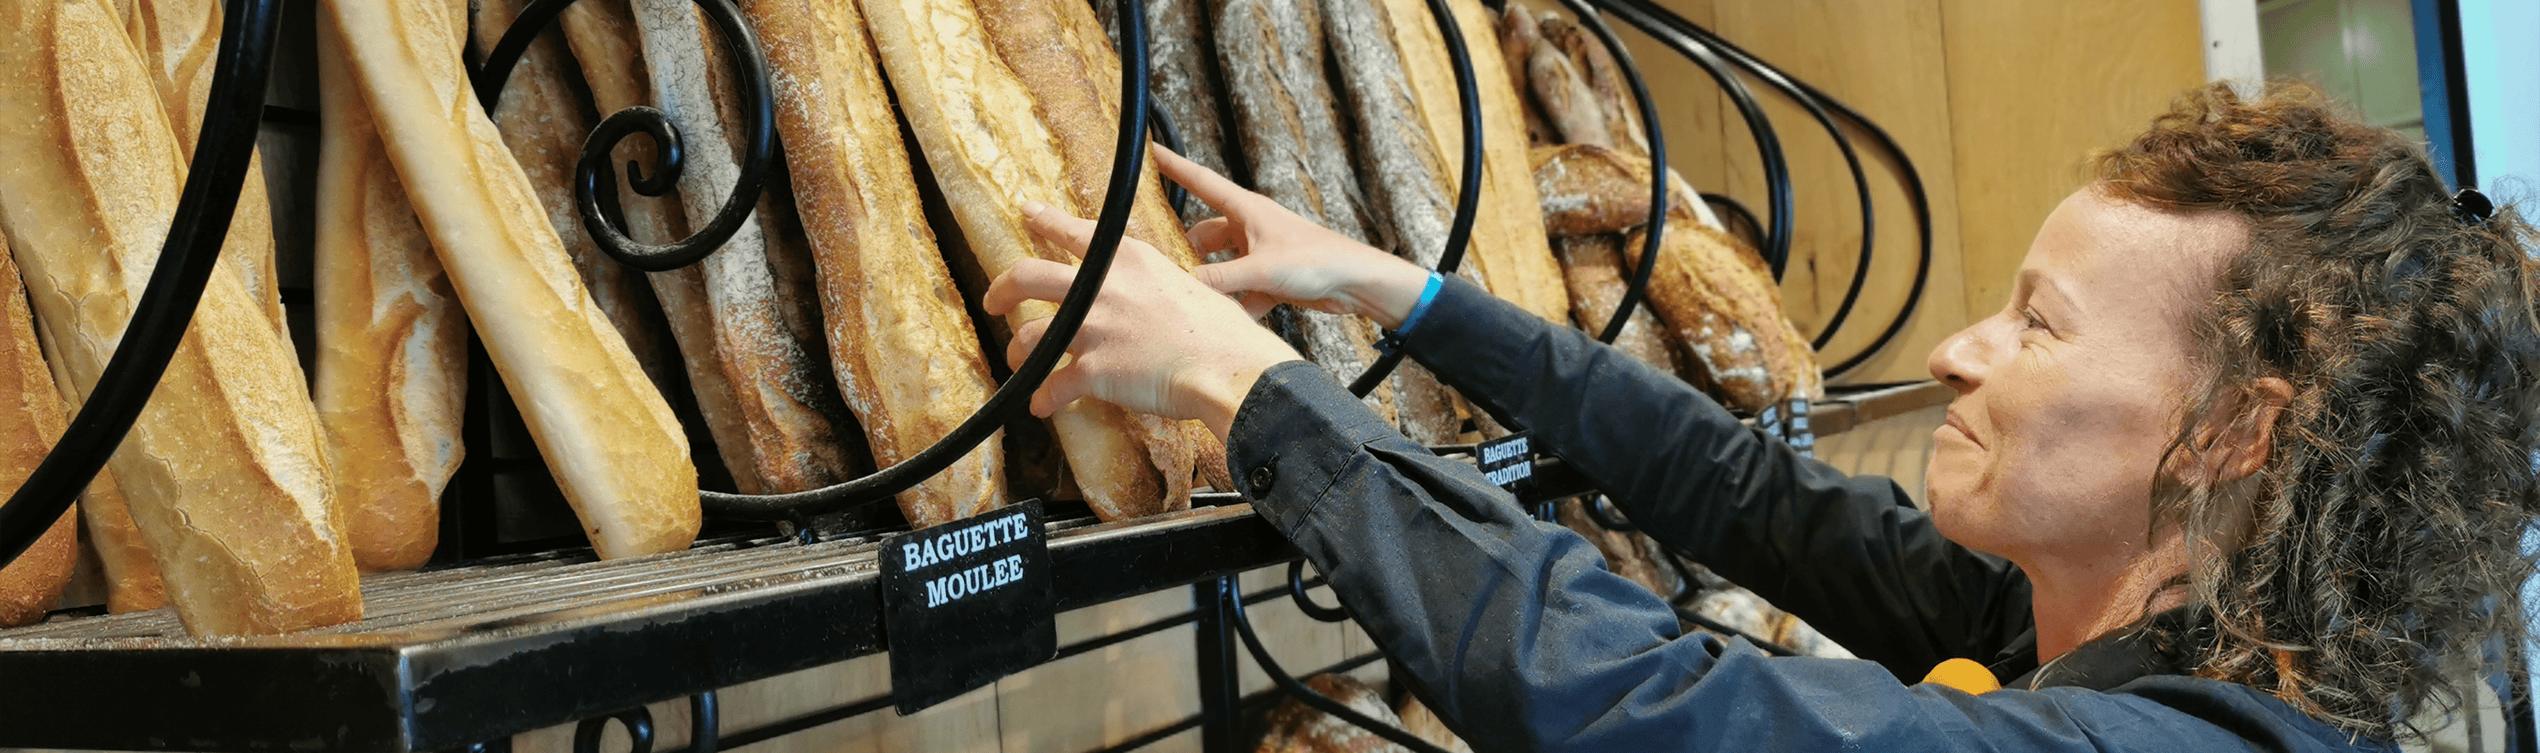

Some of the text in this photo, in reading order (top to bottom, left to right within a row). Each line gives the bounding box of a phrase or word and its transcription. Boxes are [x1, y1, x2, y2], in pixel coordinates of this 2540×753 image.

[1483, 437, 1529, 465] BAGUETTE
[902, 512, 1029, 572] BAGUETTE
[925, 554, 1024, 609] MOULEE
